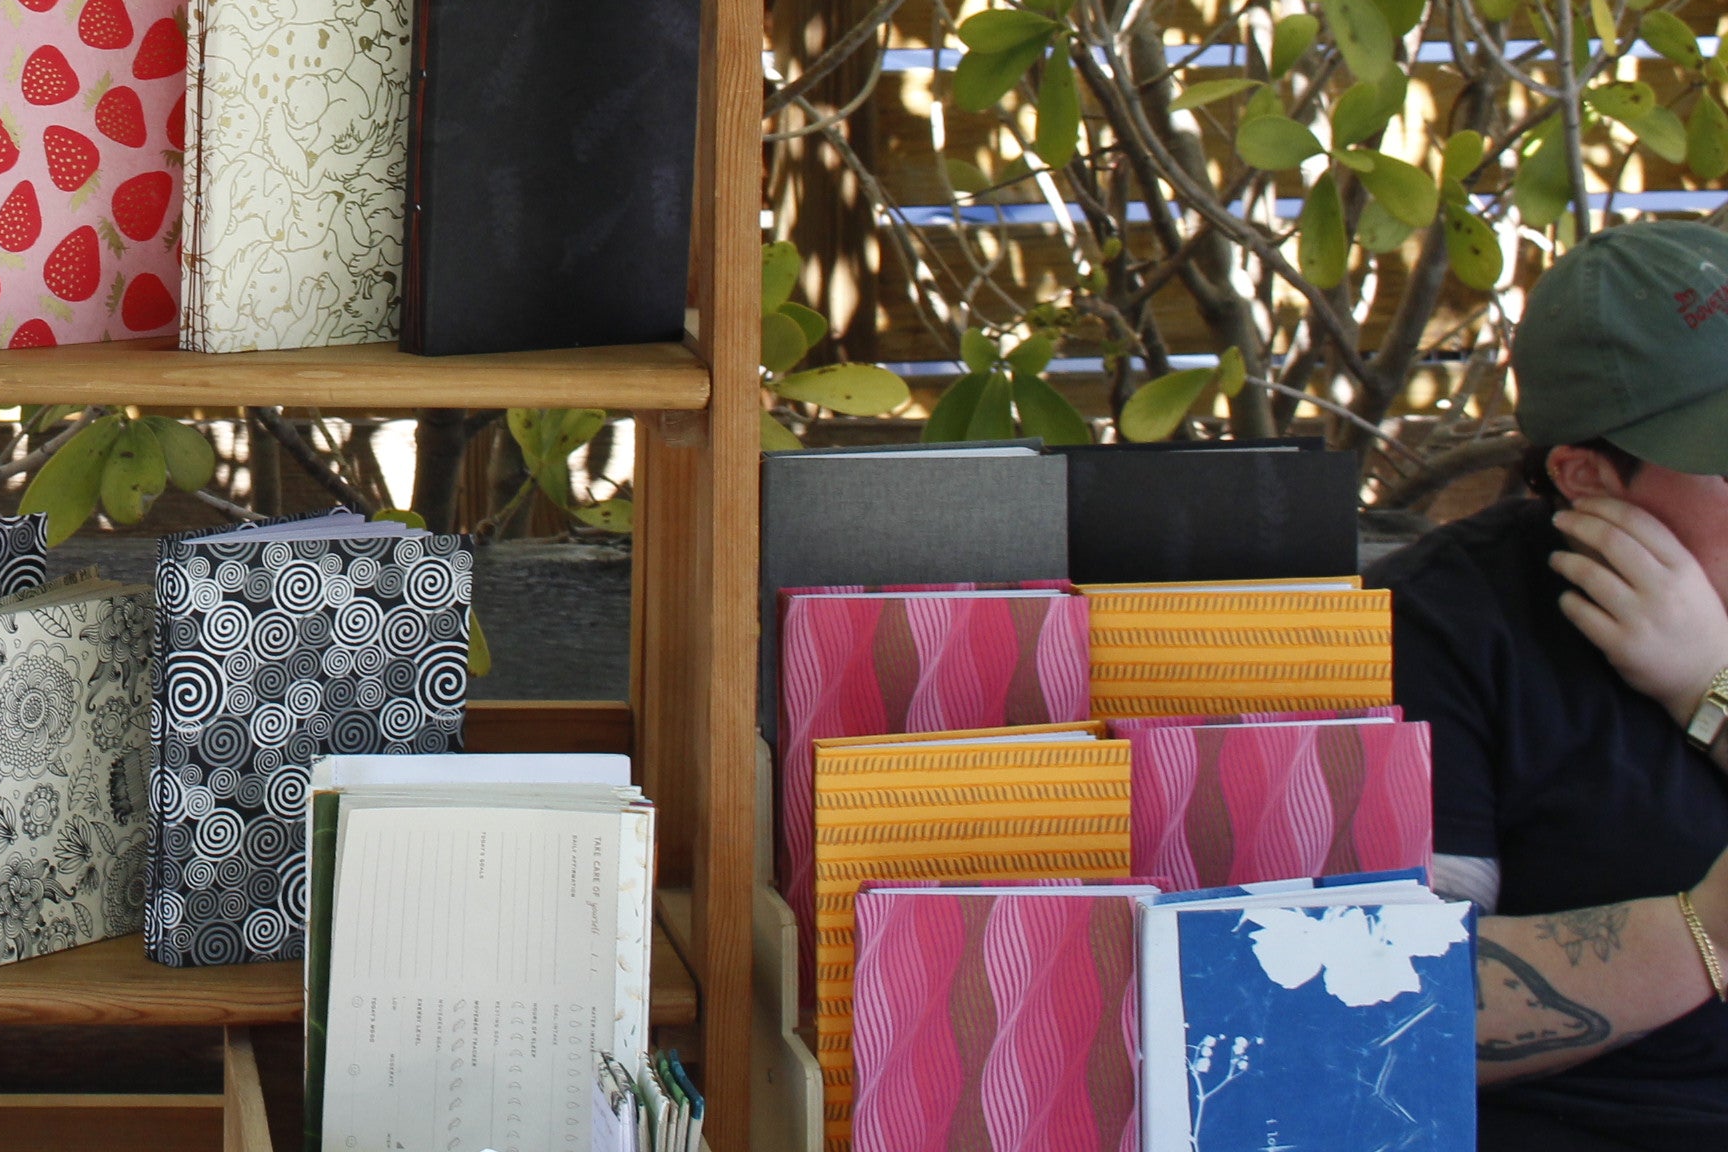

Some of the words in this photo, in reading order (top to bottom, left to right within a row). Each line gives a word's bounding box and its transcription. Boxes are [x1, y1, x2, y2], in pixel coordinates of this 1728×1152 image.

[593, 836, 602, 857] TAKE
[592, 860, 601, 883] CARE
[591, 886, 600, 898] OF
[584, 900, 601, 936] yourself
